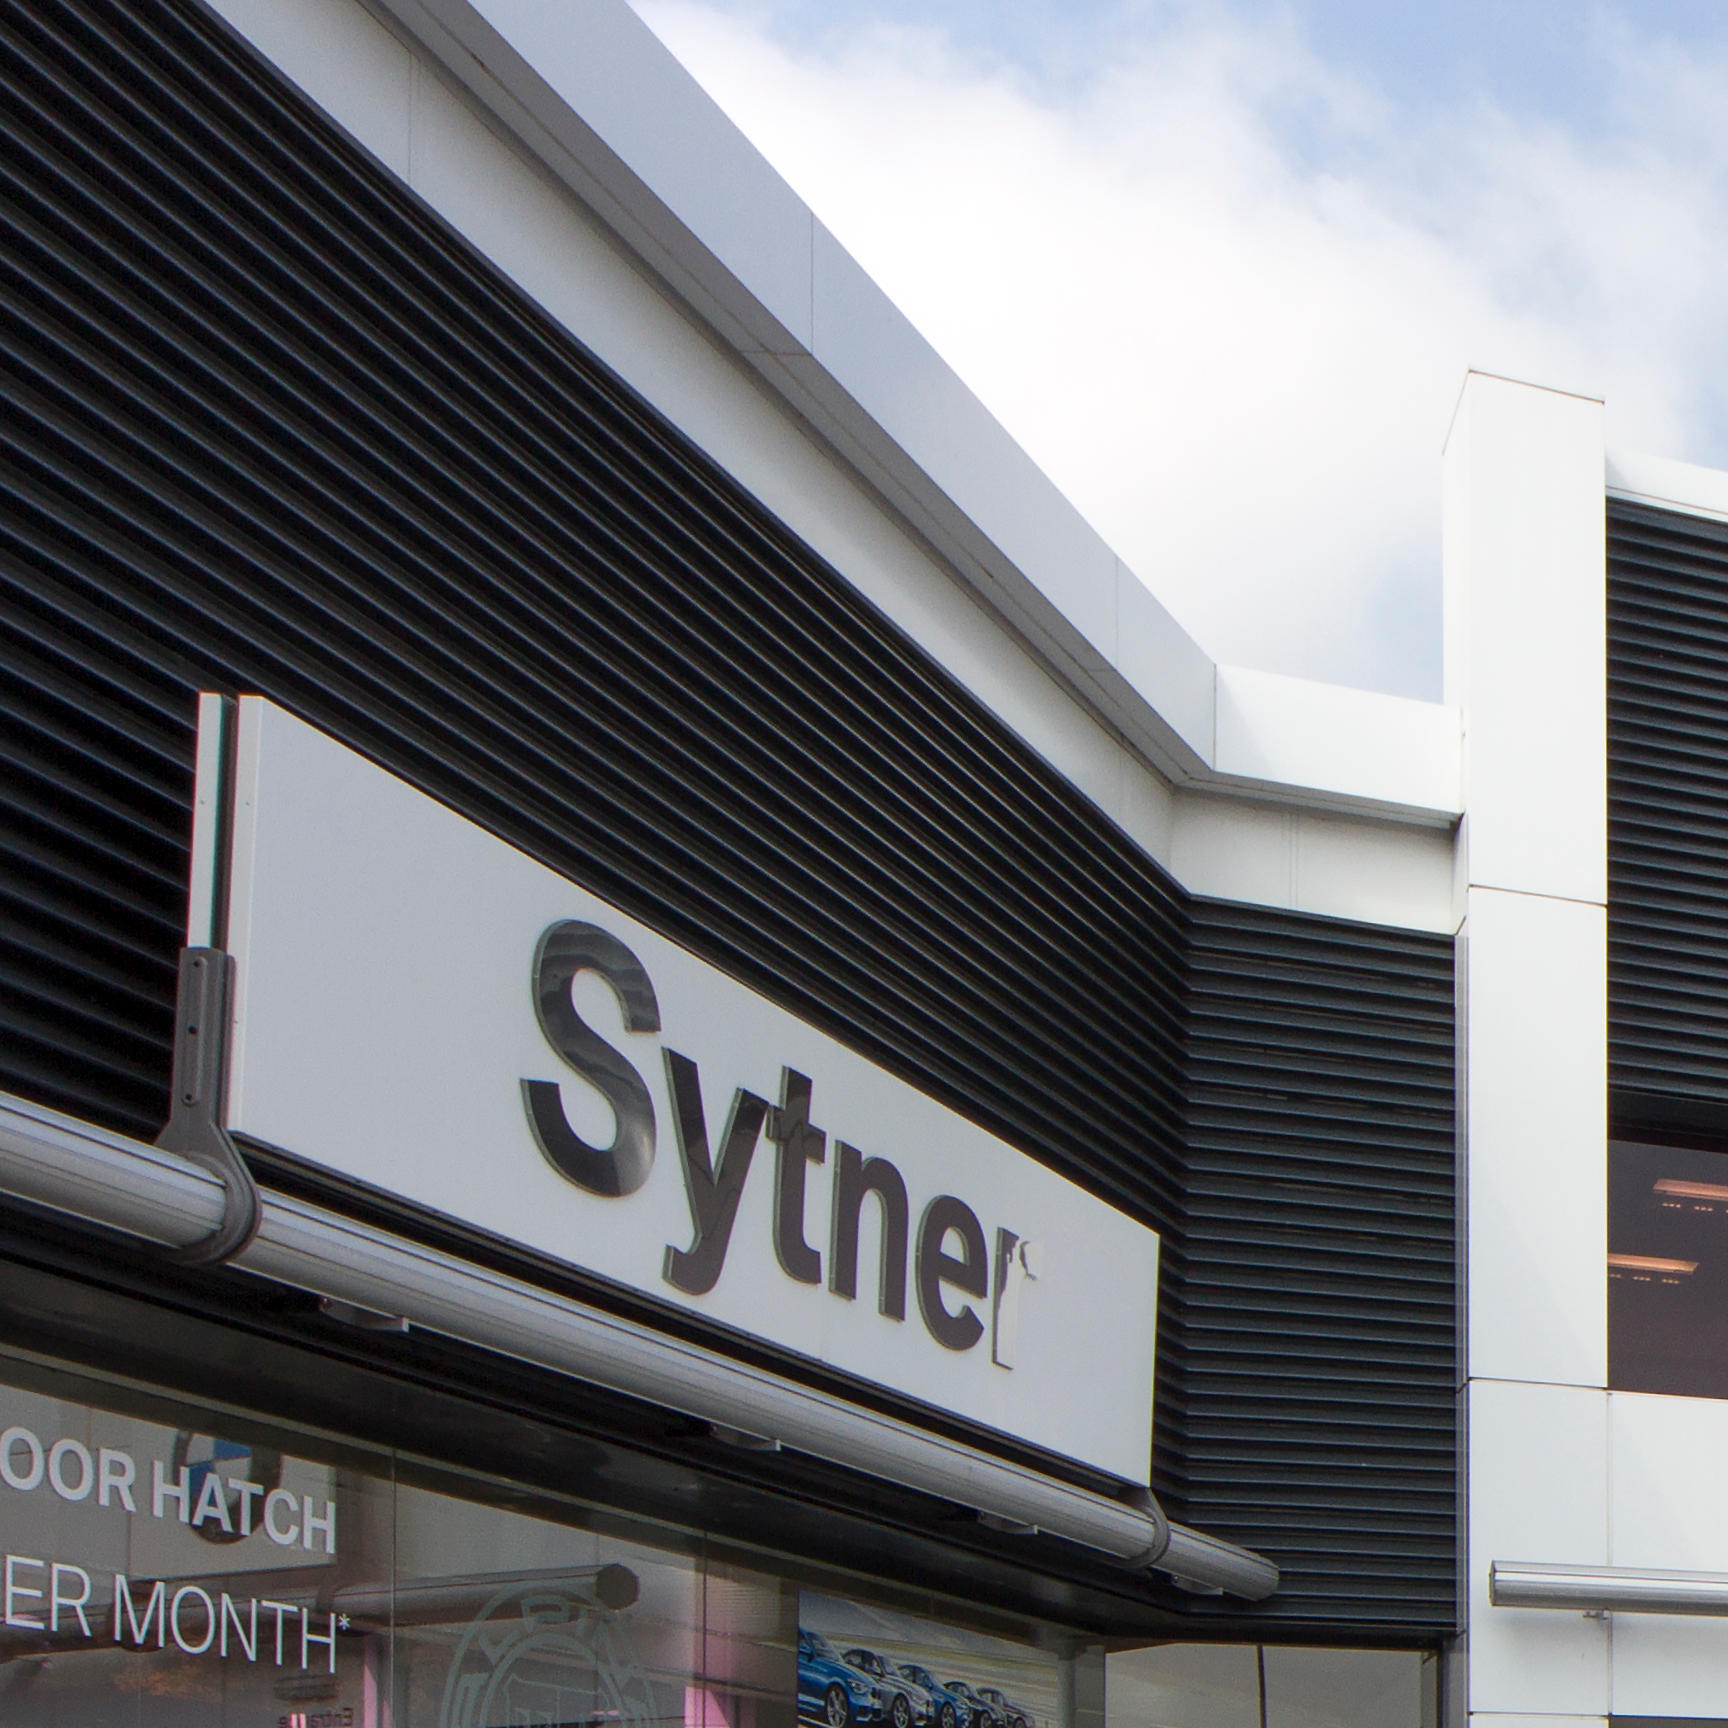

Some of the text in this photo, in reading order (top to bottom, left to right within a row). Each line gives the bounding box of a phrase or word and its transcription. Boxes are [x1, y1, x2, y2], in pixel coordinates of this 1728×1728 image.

[519, 918, 1039, 1370] Sytner
[0, 1426, 336, 1554] OOR HATCH
[5, 1554, 92, 1637] ER
